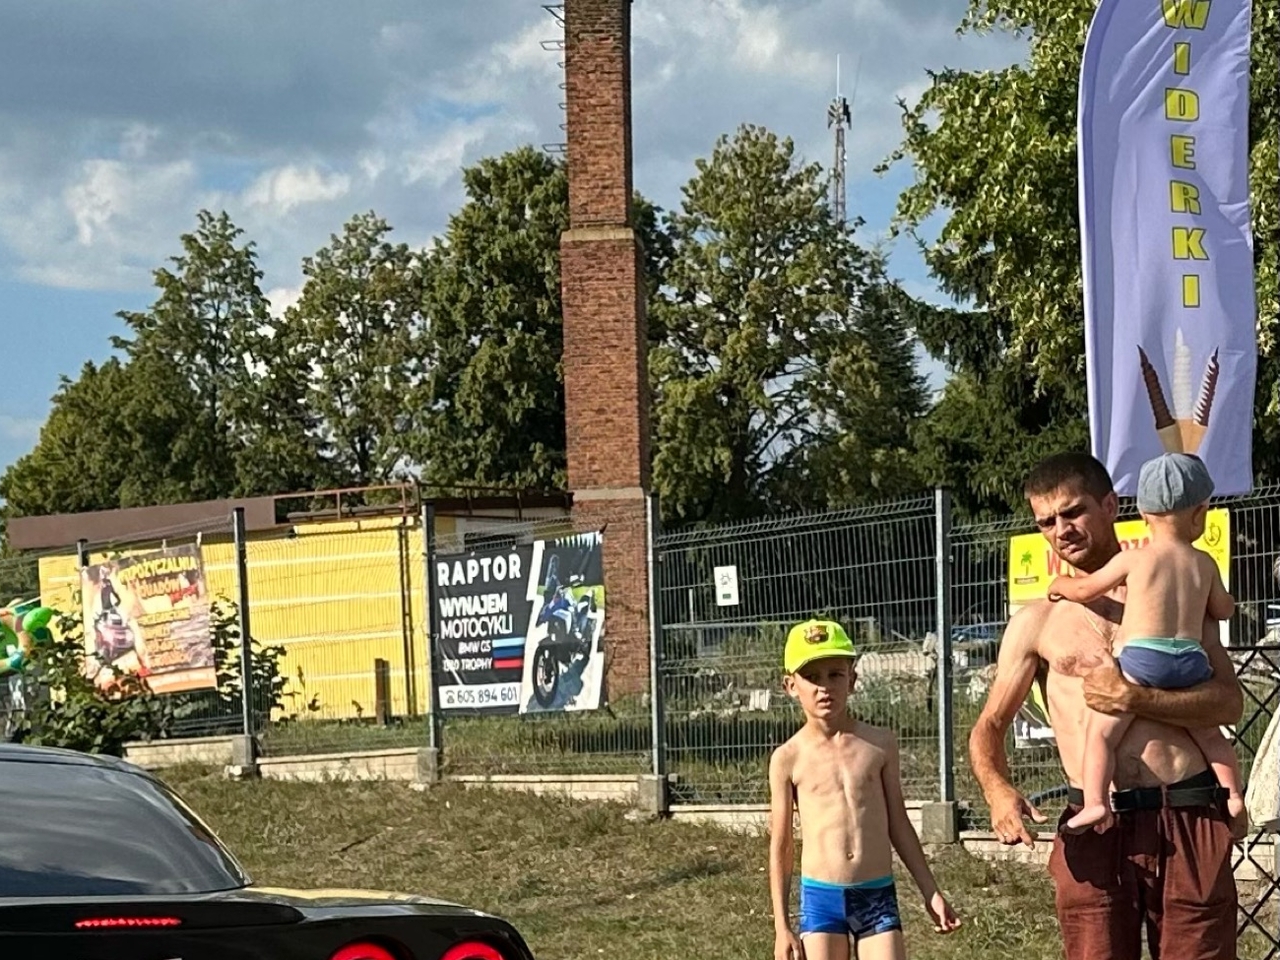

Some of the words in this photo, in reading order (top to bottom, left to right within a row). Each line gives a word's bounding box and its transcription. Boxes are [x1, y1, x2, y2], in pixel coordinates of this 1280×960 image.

[437, 553, 521, 586] RAPTOR
[439, 592, 507, 617] WYNAJEM
[440, 614, 513, 639] MOTOCYKLI
[458, 641, 480, 654] BMW
[461, 657, 493, 671] TROPHY
[457, 689, 475, 704] 605
[477, 688, 498, 704] 894
[500, 686, 518, 702] 601
